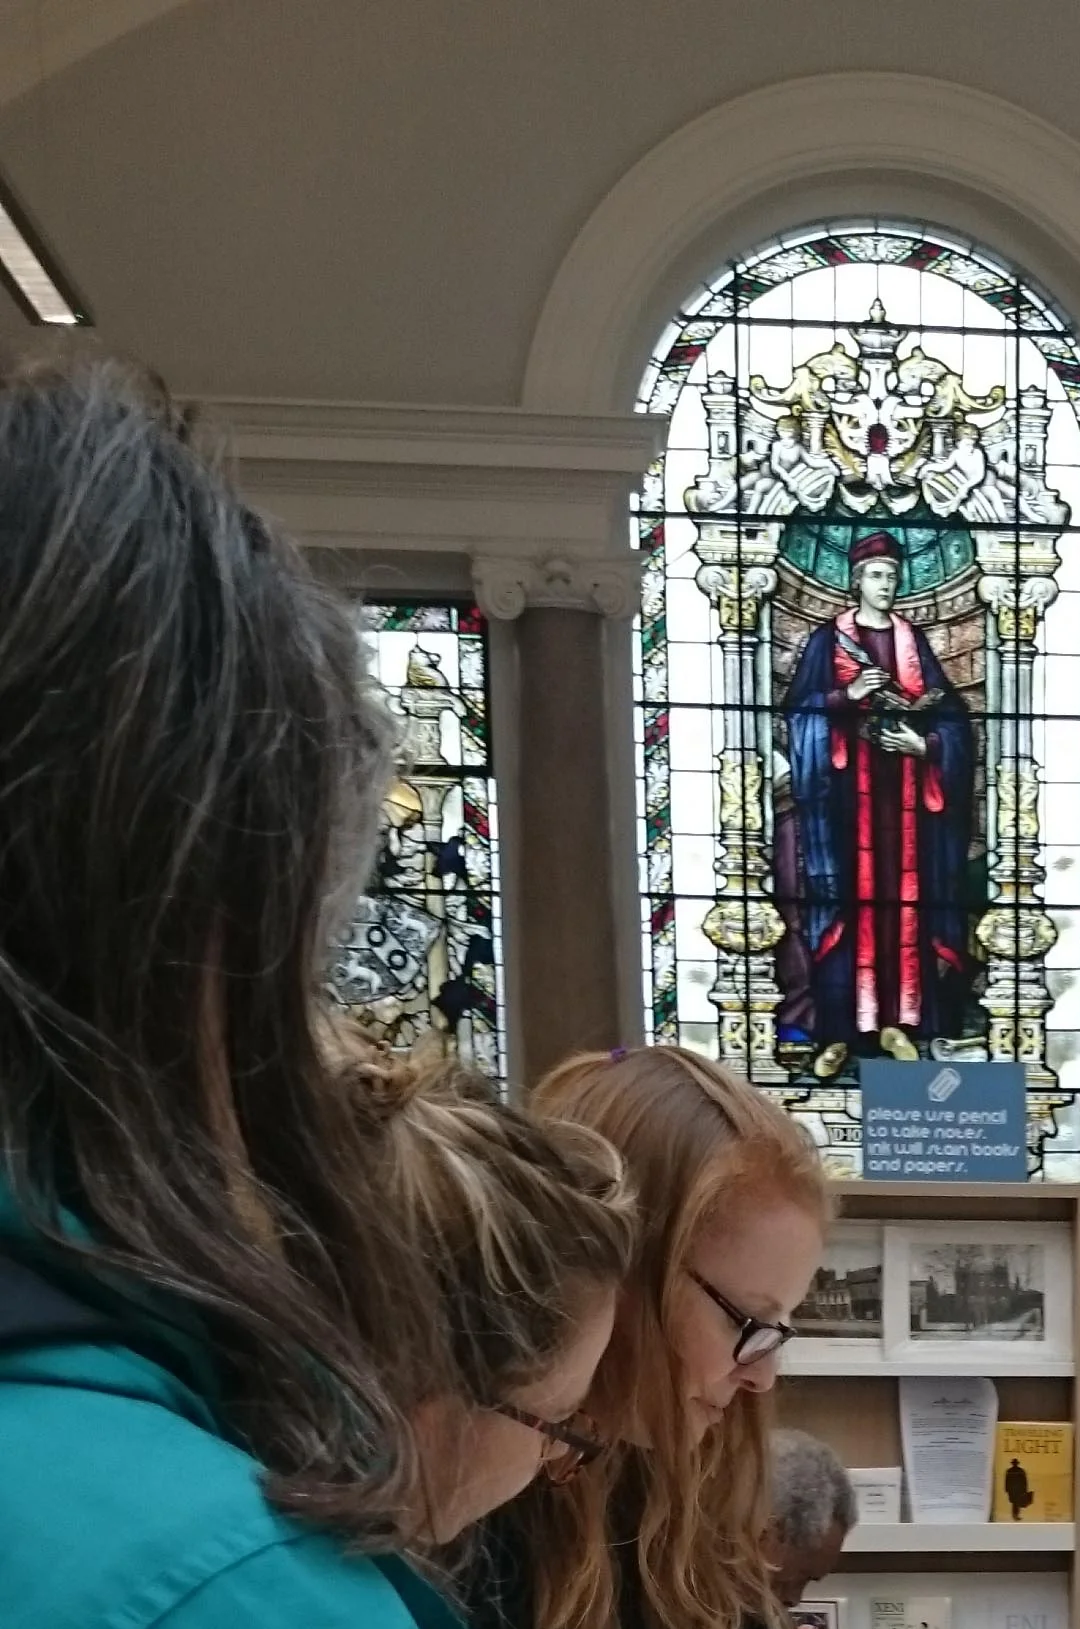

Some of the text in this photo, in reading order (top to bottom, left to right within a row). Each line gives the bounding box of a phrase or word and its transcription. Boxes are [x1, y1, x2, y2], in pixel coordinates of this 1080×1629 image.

[868, 1108, 1007, 1124] please use pencil
[868, 1125, 987, 1139] to take notes.
[895, 1142, 923, 1156] will
[926, 1143, 968, 1156] stain
[972, 1143, 1019, 1157] books
[869, 1158, 968, 1175] and papers.
[1003, 1439, 1062, 1454] LIGHT
